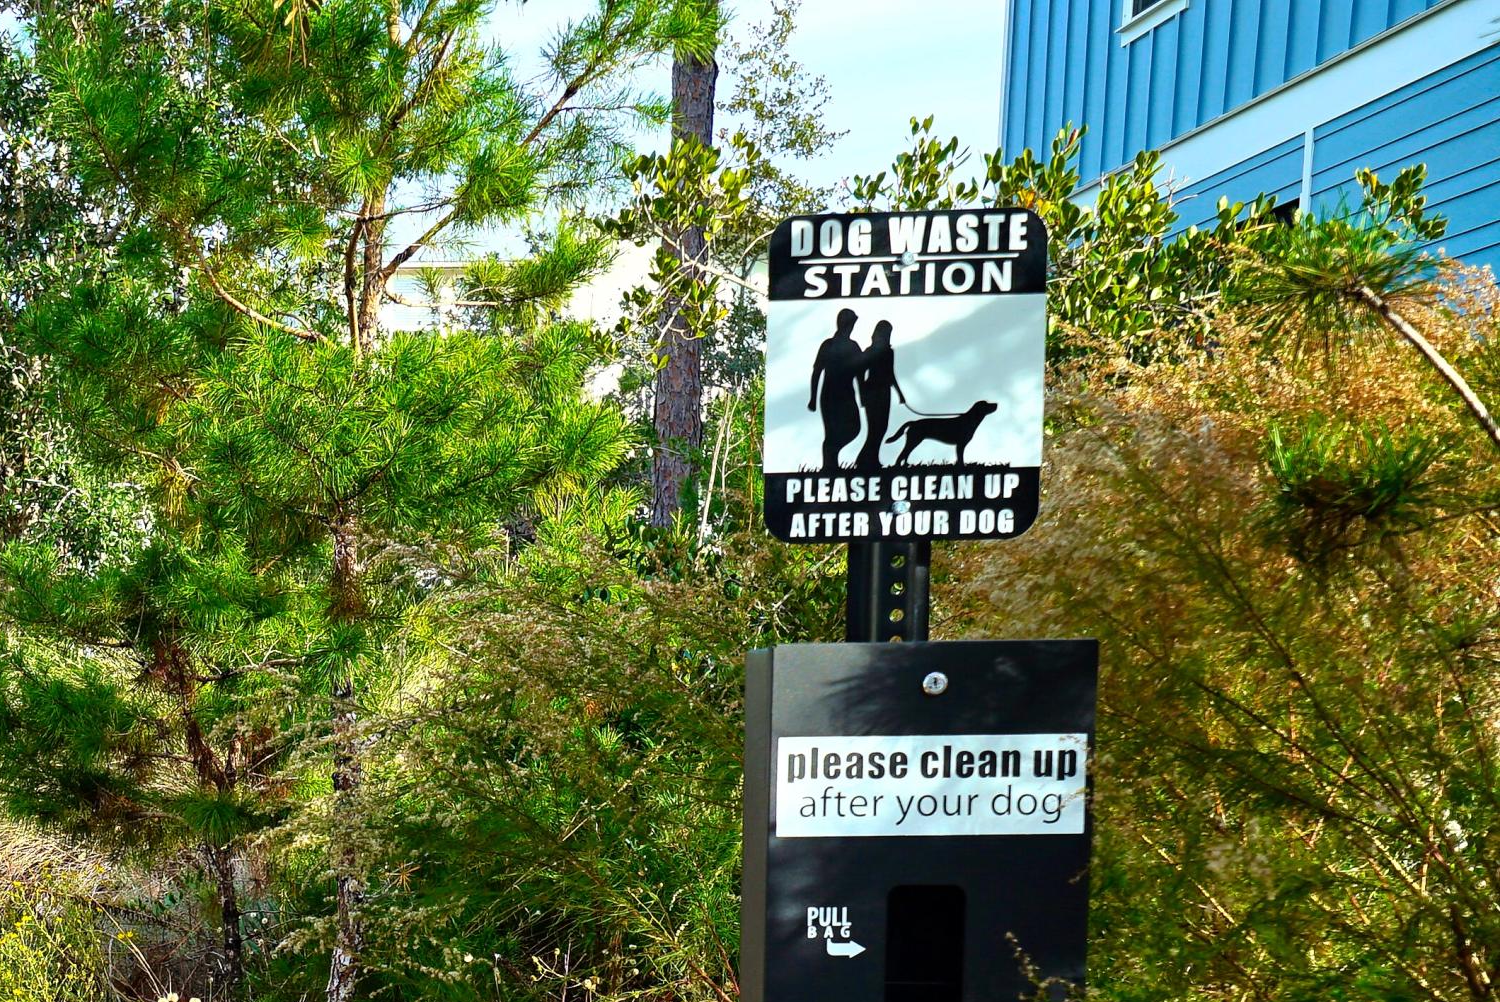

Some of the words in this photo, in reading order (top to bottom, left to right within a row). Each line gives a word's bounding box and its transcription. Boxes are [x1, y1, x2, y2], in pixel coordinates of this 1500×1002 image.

[790, 218, 873, 257] DOG
[888, 213, 1028, 254] WASTE
[803, 261, 1013, 298] STATION
[786, 477, 881, 503] PLEASE
[891, 475, 973, 502] CLEAN
[984, 474, 1020, 500] UP
[789, 512, 870, 538] AFTER
[879, 510, 949, 537] YOUR
[959, 509, 1014, 535] DOG
[787, 747, 908, 783] please
[920, 745, 1021, 778] clean
[1033, 749, 1077, 781] up
[799, 786, 884, 818] after
[895, 794, 979, 826] your
[991, 785, 1063, 824] dog
[807, 907, 851, 927] PULL
[807, 926, 851, 939] BAG
